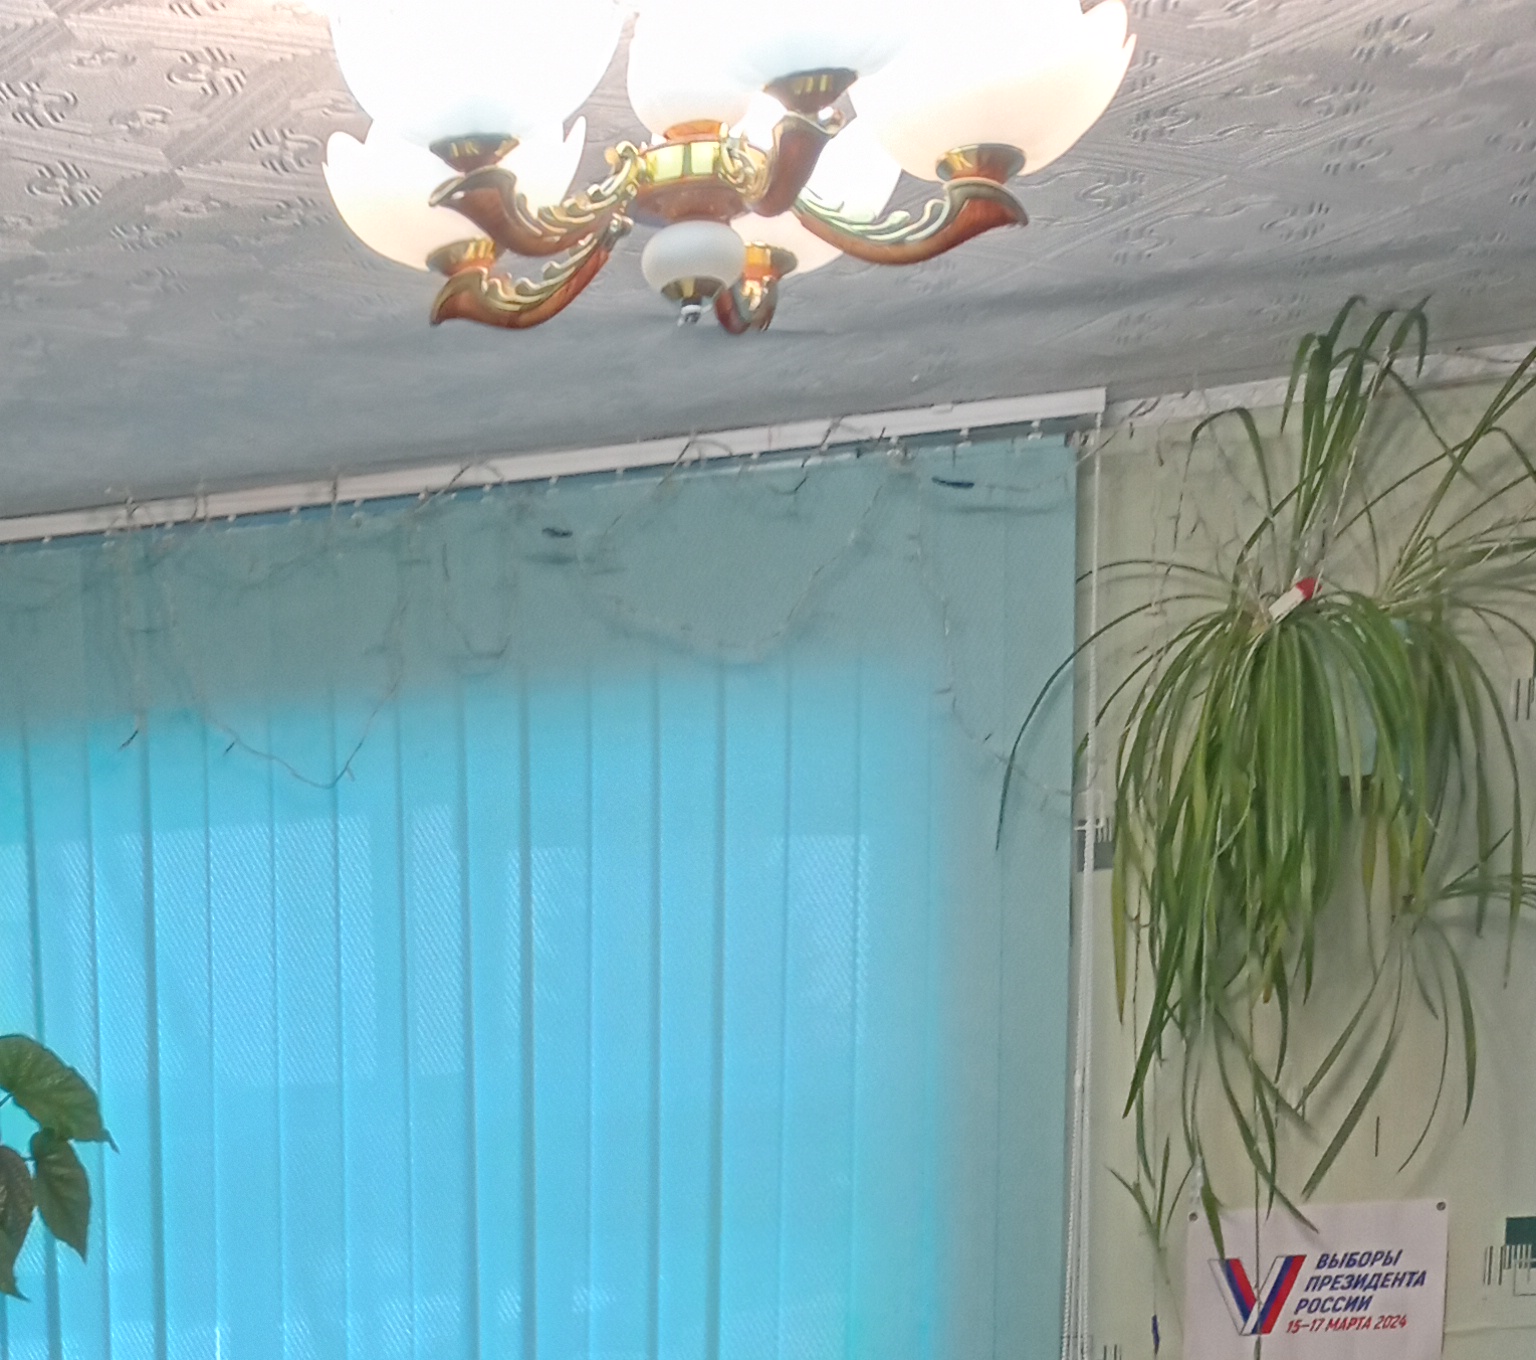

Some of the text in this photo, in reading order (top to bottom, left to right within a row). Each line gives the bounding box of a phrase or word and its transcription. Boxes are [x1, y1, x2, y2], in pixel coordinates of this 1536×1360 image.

[1315, 1249, 1403, 1270] ВЫБОРЫ
[1304, 1270, 1427, 1293] ПРЕЗИДЕНТА
[1293, 1295, 1374, 1315] РОССИИ
[1325, 1315, 1372, 1332] МАРТА
[1373, 1314, 1408, 1330] 2024
